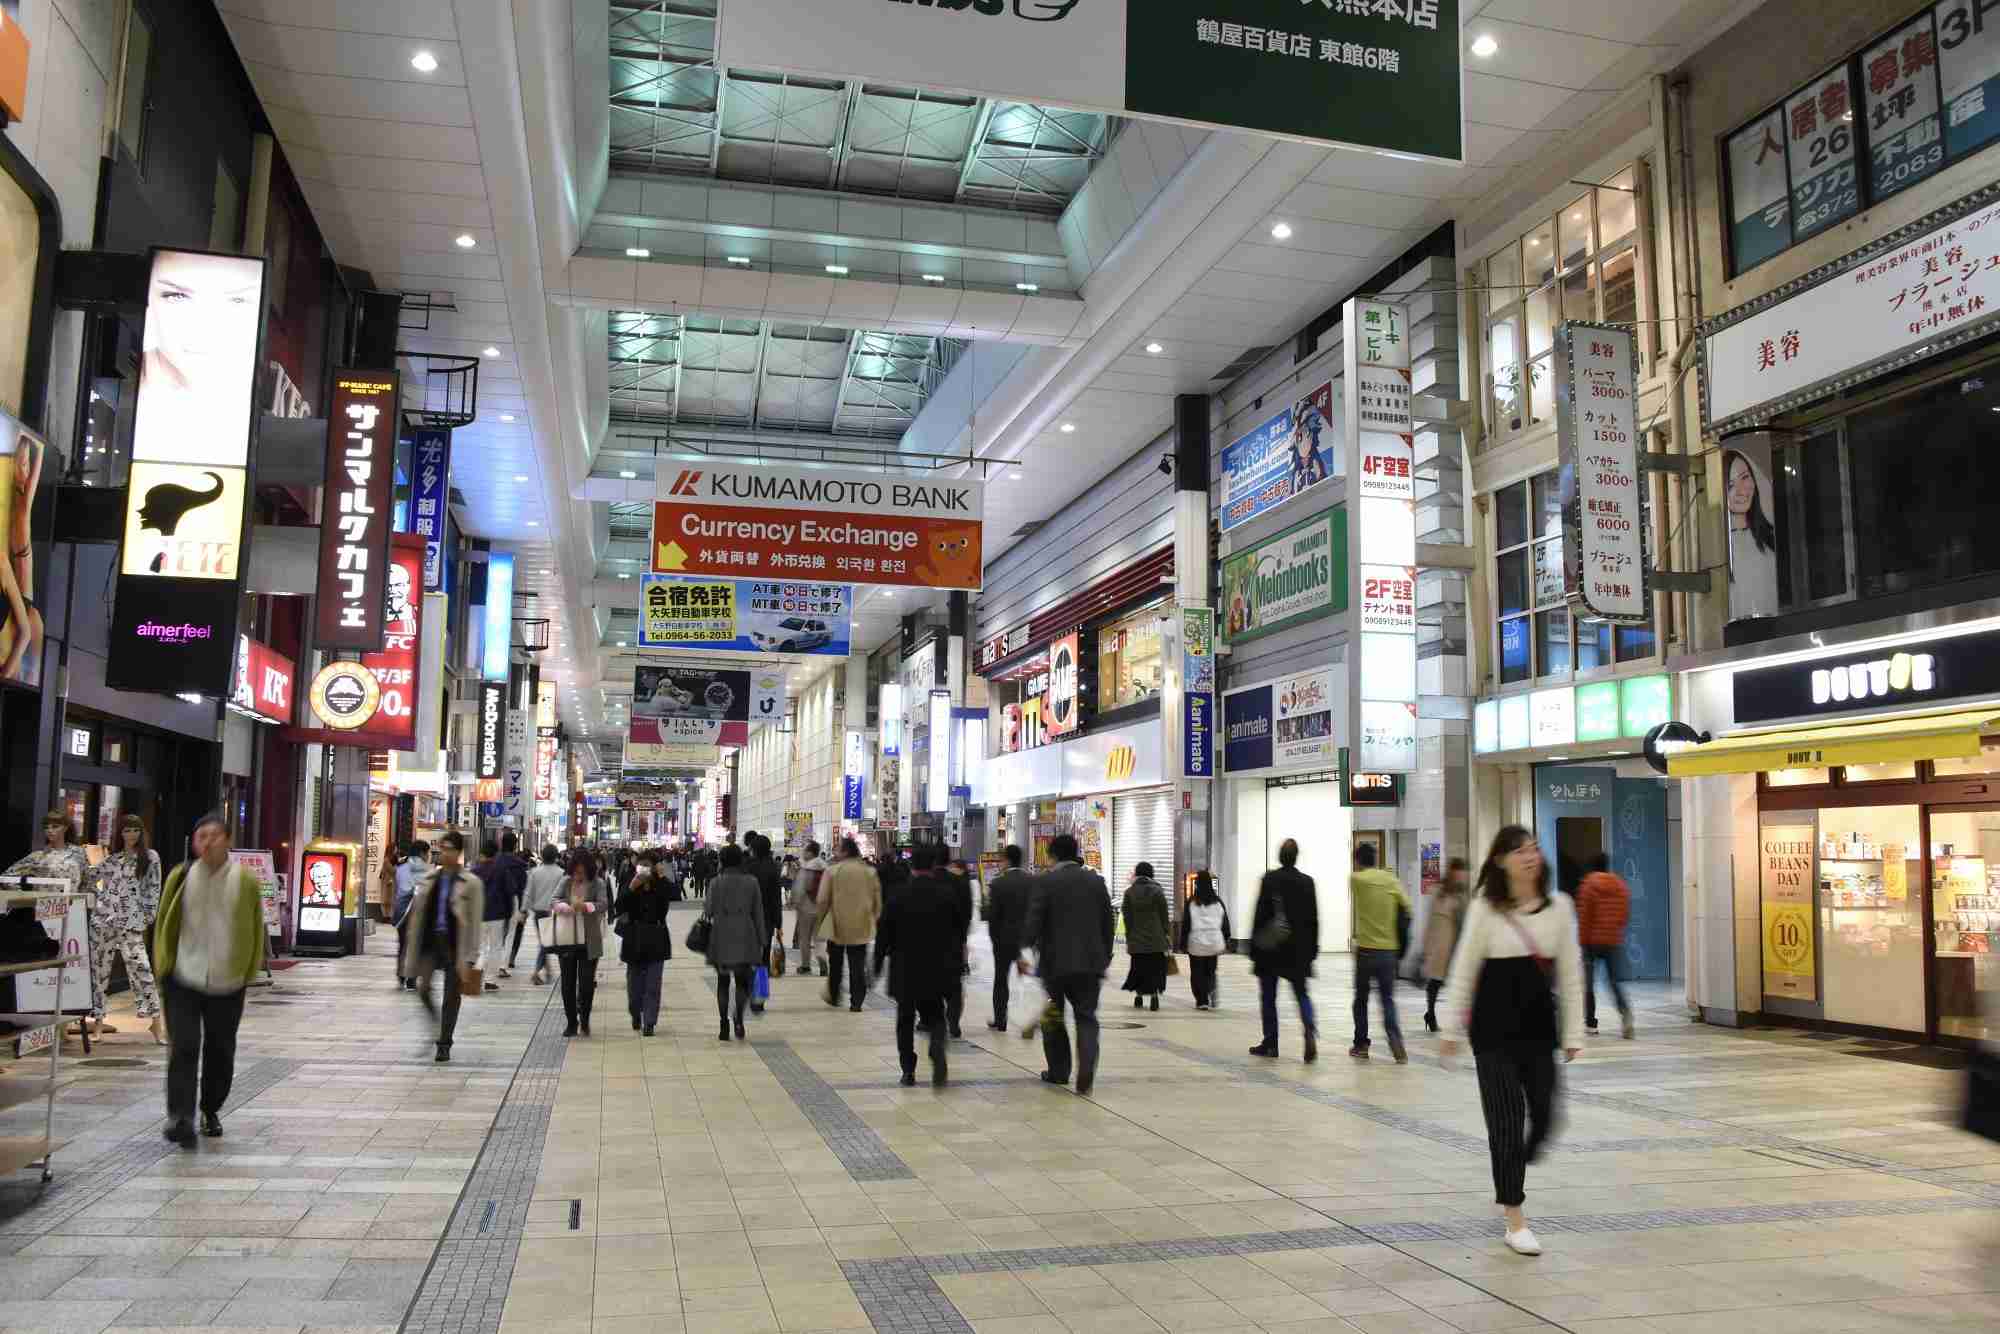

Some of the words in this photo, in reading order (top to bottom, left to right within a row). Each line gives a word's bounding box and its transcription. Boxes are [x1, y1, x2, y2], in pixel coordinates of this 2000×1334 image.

[1196, 18, 1312, 58] 鶴屋百貨店
[1319, 38, 1400, 73] 東館6階
[1758, 329, 1800, 372] 美容
[711, 473, 882, 504] KUMAMOTO
[892, 484, 969, 511] BANK
[337, 404, 380, 627] サンマルクカフェ
[681, 513, 796, 546] Currency
[800, 521, 919, 550] Exchange
[647, 585, 731, 606] 合宿免許
[650, 607, 732, 618] 大矢野自動車学校
[136, 621, 212, 639] aimerfeel
[1811, 652, 1936, 705] DOUTOR
[1231, 714, 1269, 738] animate
[1769, 856, 1810, 871] BEANS
[1777, 872, 1801, 886] DAY
